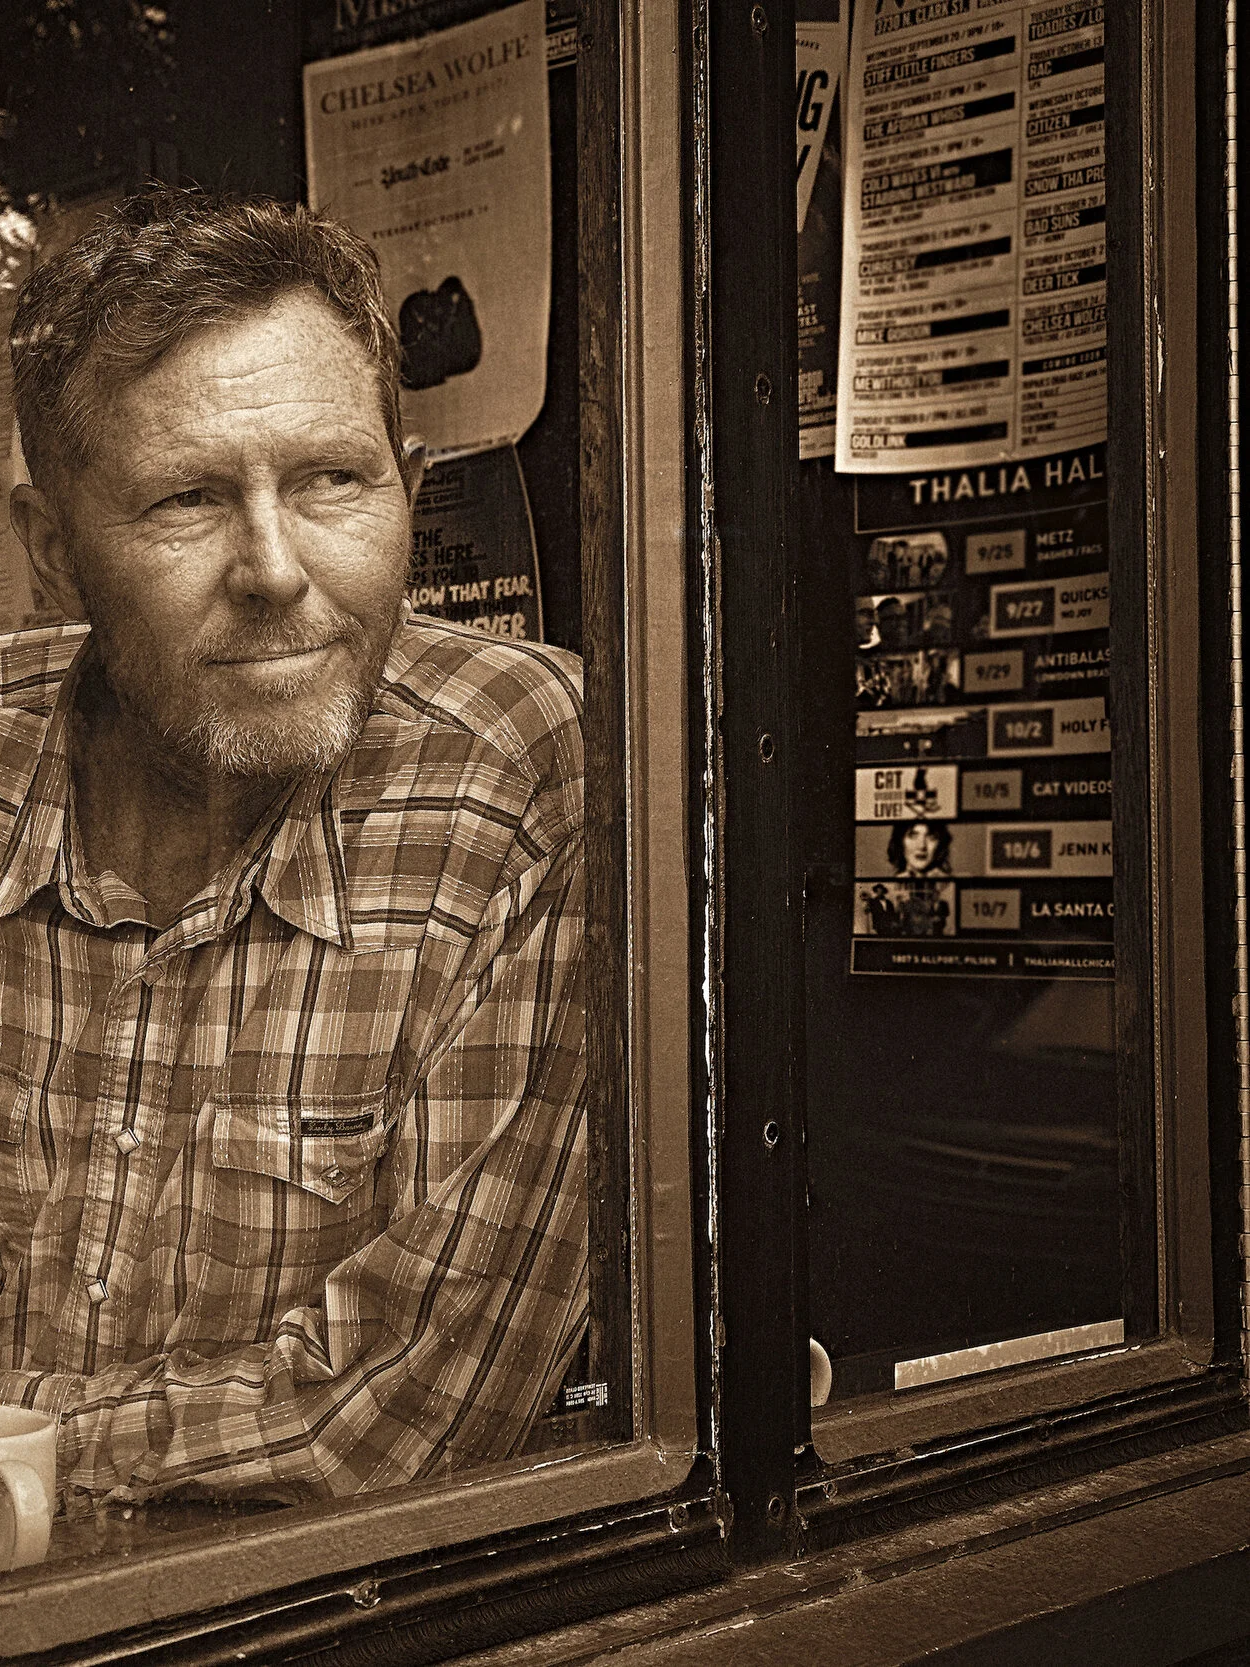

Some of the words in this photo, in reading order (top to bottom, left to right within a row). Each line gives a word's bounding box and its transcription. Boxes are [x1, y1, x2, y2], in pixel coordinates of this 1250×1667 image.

[915, 3, 948, 24] CLARK
[1031, 15, 1077, 39] TOADIES
[1088, 7, 1104, 24] LO
[908, 34, 949, 53] SEPTEMBER
[320, 70, 438, 115] CHELSEA
[443, 34, 530, 82] WOLFE
[865, 66, 892, 87] STIFF
[894, 58, 928, 80] LITTLE
[931, 48, 975, 69] FINGERS
[1030, 61, 1052, 78] RAC
[866, 123, 884, 140] THE
[887, 115, 928, 136] AFGHAN
[1028, 114, 1070, 135] CITIZEN
[862, 176, 890, 192] COLD
[891, 168, 927, 188] WAVES
[1026, 177, 1059, 195] SNOW
[1062, 170, 1084, 189] THA
[1026, 218, 1049, 236] BAD
[1051, 212, 1080, 231] SUNS
[1025, 276, 1054, 294] DEER
[1056, 270, 1080, 289] TICK
[1024, 313, 1071, 335] CHELSEA
[1073, 306, 1106, 326] WOLFE
[857, 327, 885, 343] MIKE
[909, 465, 1032, 505] THALIA
[1044, 454, 1104, 488] HAL
[1035, 528, 1074, 548] METZ
[448, 580, 491, 604] THAT
[1005, 600, 1043, 619] 9/27
[1060, 587, 1109, 604] QUICKS
[1034, 648, 1112, 668] ANTIBALAS
[1005, 721, 1043, 739] 10/2
[1060, 718, 1097, 734] HOLY
[874, 771, 904, 791] CAT
[1032, 782, 1059, 796] CAT
[1064, 780, 1112, 796] VIDEOS
[1057, 843, 1098, 857] JENN
[972, 901, 1008, 918] 10/7
[1031, 903, 1051, 917] LA
[1053, 902, 1104, 917] SANTA
